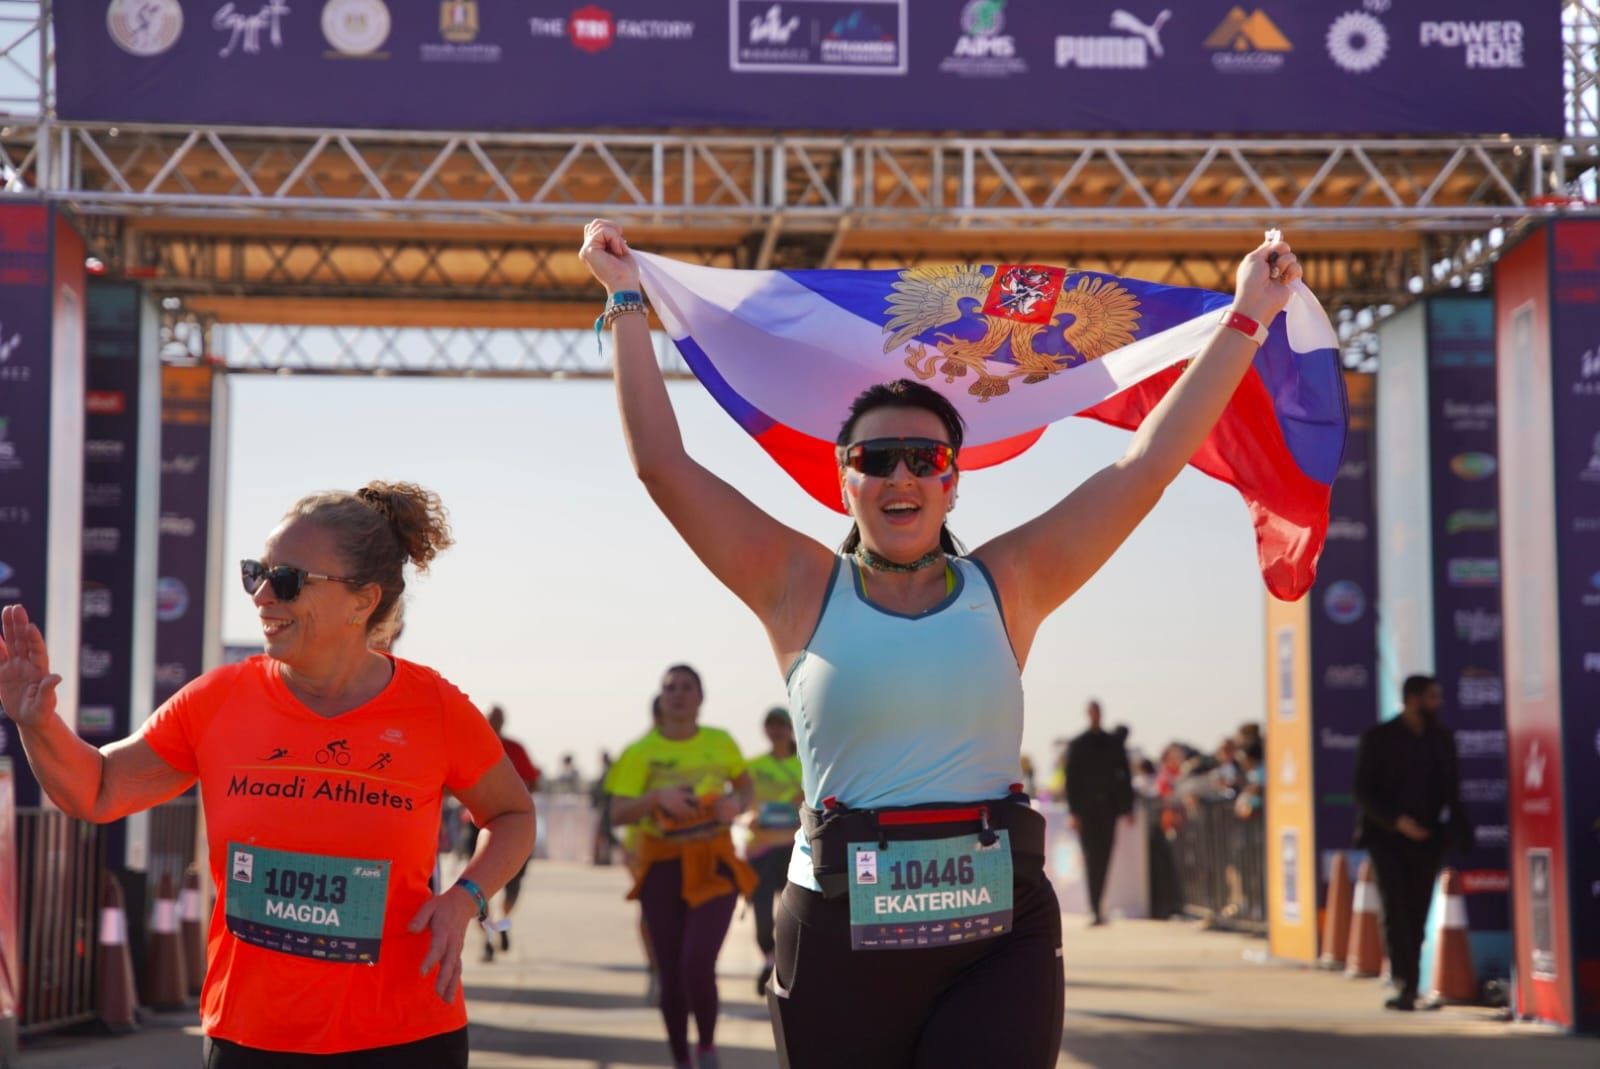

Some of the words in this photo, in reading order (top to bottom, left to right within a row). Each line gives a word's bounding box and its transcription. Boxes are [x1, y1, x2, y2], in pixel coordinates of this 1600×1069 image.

[529, 18, 563, 36] THE
[574, 19, 608, 38] TRI
[618, 20, 695, 40] FACTORY
[1420, 21, 1524, 46] POWER
[954, 36, 1016, 56] AIMS
[1055, 35, 1147, 68] PUMA
[227, 775, 305, 798] Maadi
[313, 778, 414, 811] Athletes
[264, 868, 347, 904] 10913
[890, 855, 974, 890] 10446
[266, 899, 341, 927] MAGDA
[875, 887, 991, 914] EKATERINA
